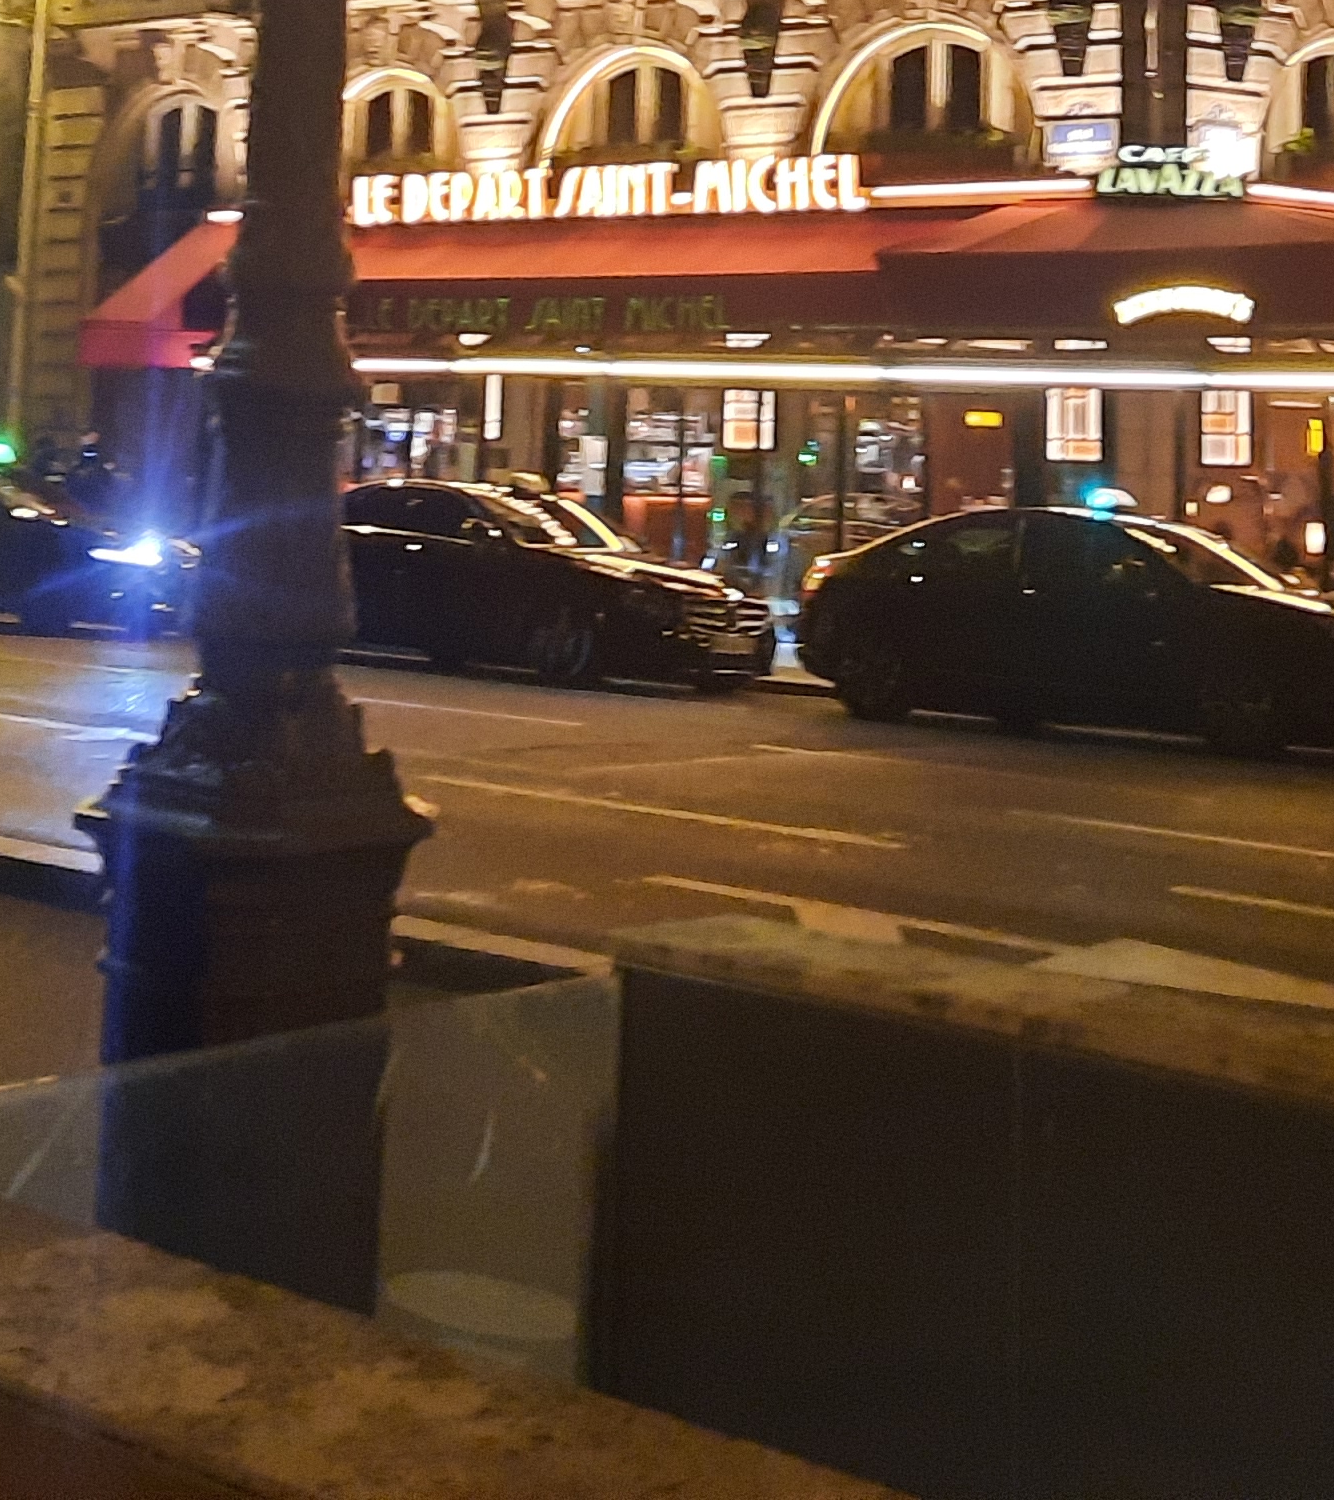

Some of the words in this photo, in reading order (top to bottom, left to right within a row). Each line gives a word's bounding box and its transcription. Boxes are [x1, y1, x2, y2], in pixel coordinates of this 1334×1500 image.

[352, 175, 398, 227] LE
[401, 168, 553, 223] DEPART
[553, 154, 867, 218] SAINT-MICHEL
[1097, 164, 1244, 198] LAVAZZA
